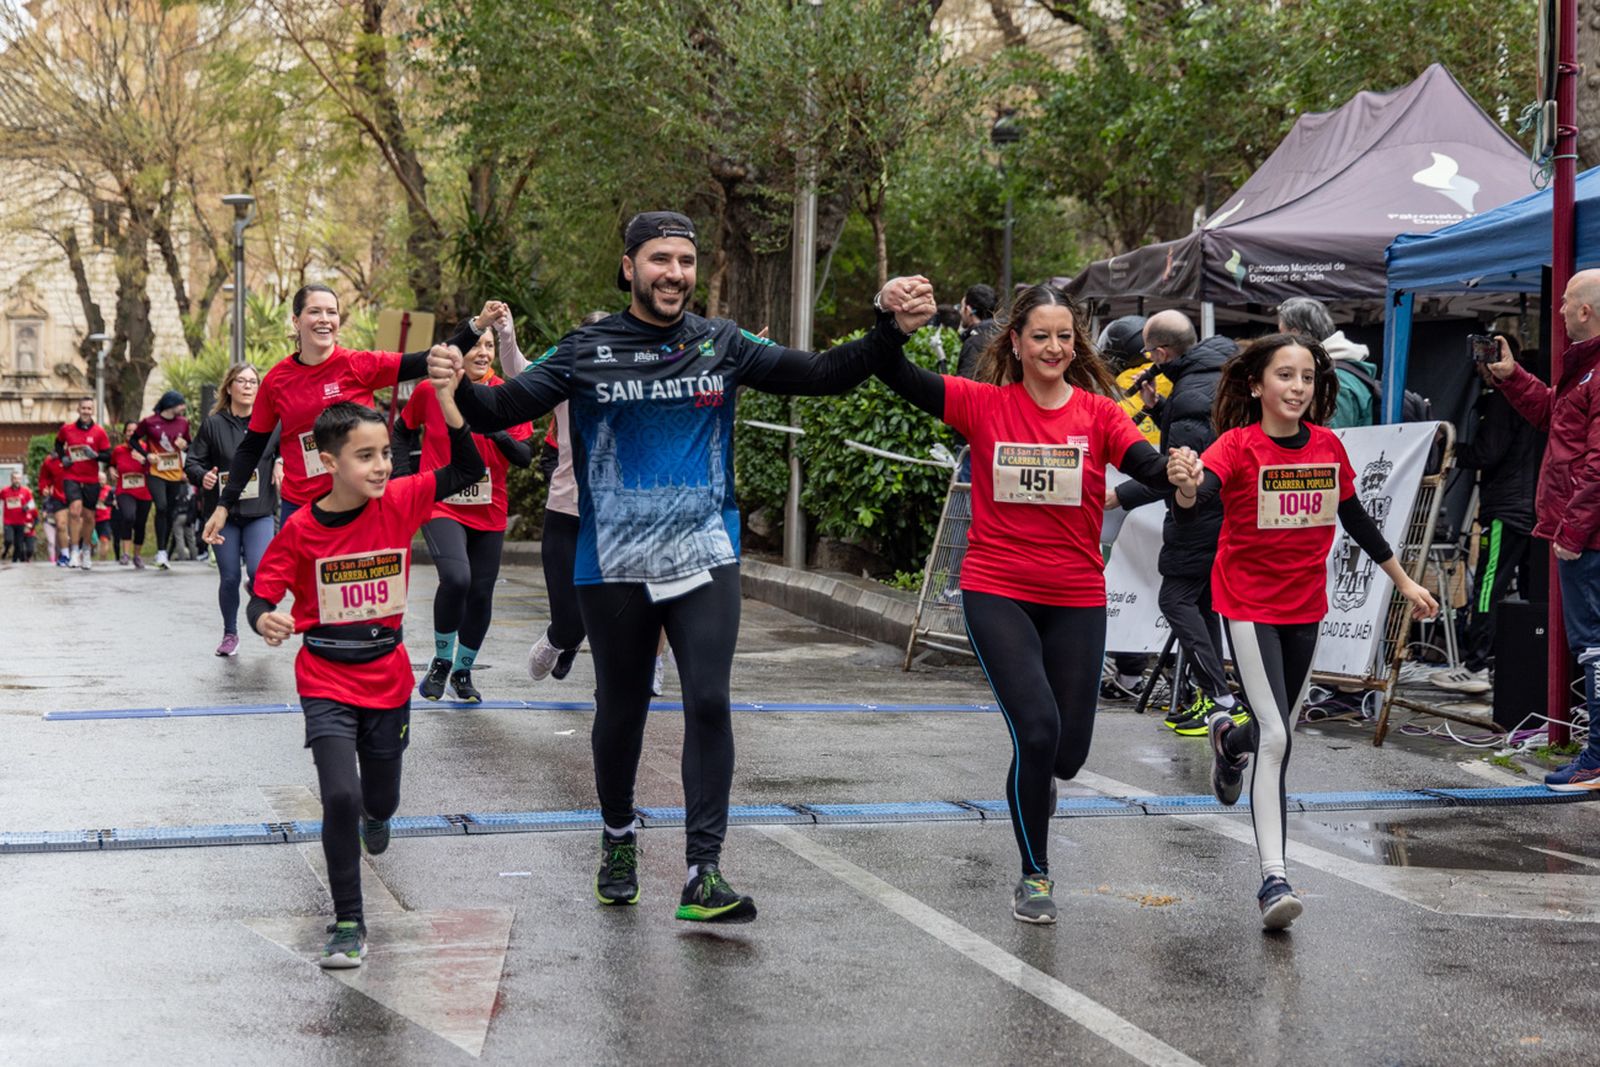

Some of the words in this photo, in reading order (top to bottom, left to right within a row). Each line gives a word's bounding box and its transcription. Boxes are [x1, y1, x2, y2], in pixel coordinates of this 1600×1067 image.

[1248, 264, 1290, 274] Patronato
[1291, 262, 1333, 273] Municipal
[1334, 262, 1346, 271] de
[1249, 273, 1288, 284] Deportes
[1290, 273, 1301, 281] de
[595, 380, 643, 404] SAN
[651, 370, 724, 400] ANTÓN
[1017, 448, 1031, 456] San
[1008, 456, 1041, 466] CARRERA
[1043, 457, 1076, 467] POPULAR
[1020, 468, 1055, 492] 451
[1268, 471, 1279, 479] IES
[1281, 471, 1295, 479] San
[1296, 470, 1312, 478] Juan
[1313, 469, 1332, 477] Bosco
[459, 483, 479, 497] 80
[1265, 481, 1271, 490] V
[1272, 480, 1305, 490] CARRERA
[1306, 479, 1334, 489] POPULAR
[1279, 492, 1323, 515] 1048
[326, 562, 338, 571] IES
[341, 560, 356, 570] San
[324, 573, 330, 582] V
[332, 570, 368, 582] CARRERA
[369, 563, 400, 578] POPULAR
[340, 580, 389, 608] 1049
[1125, 592, 1138, 604] de
[1339, 622, 1352, 639] DE
